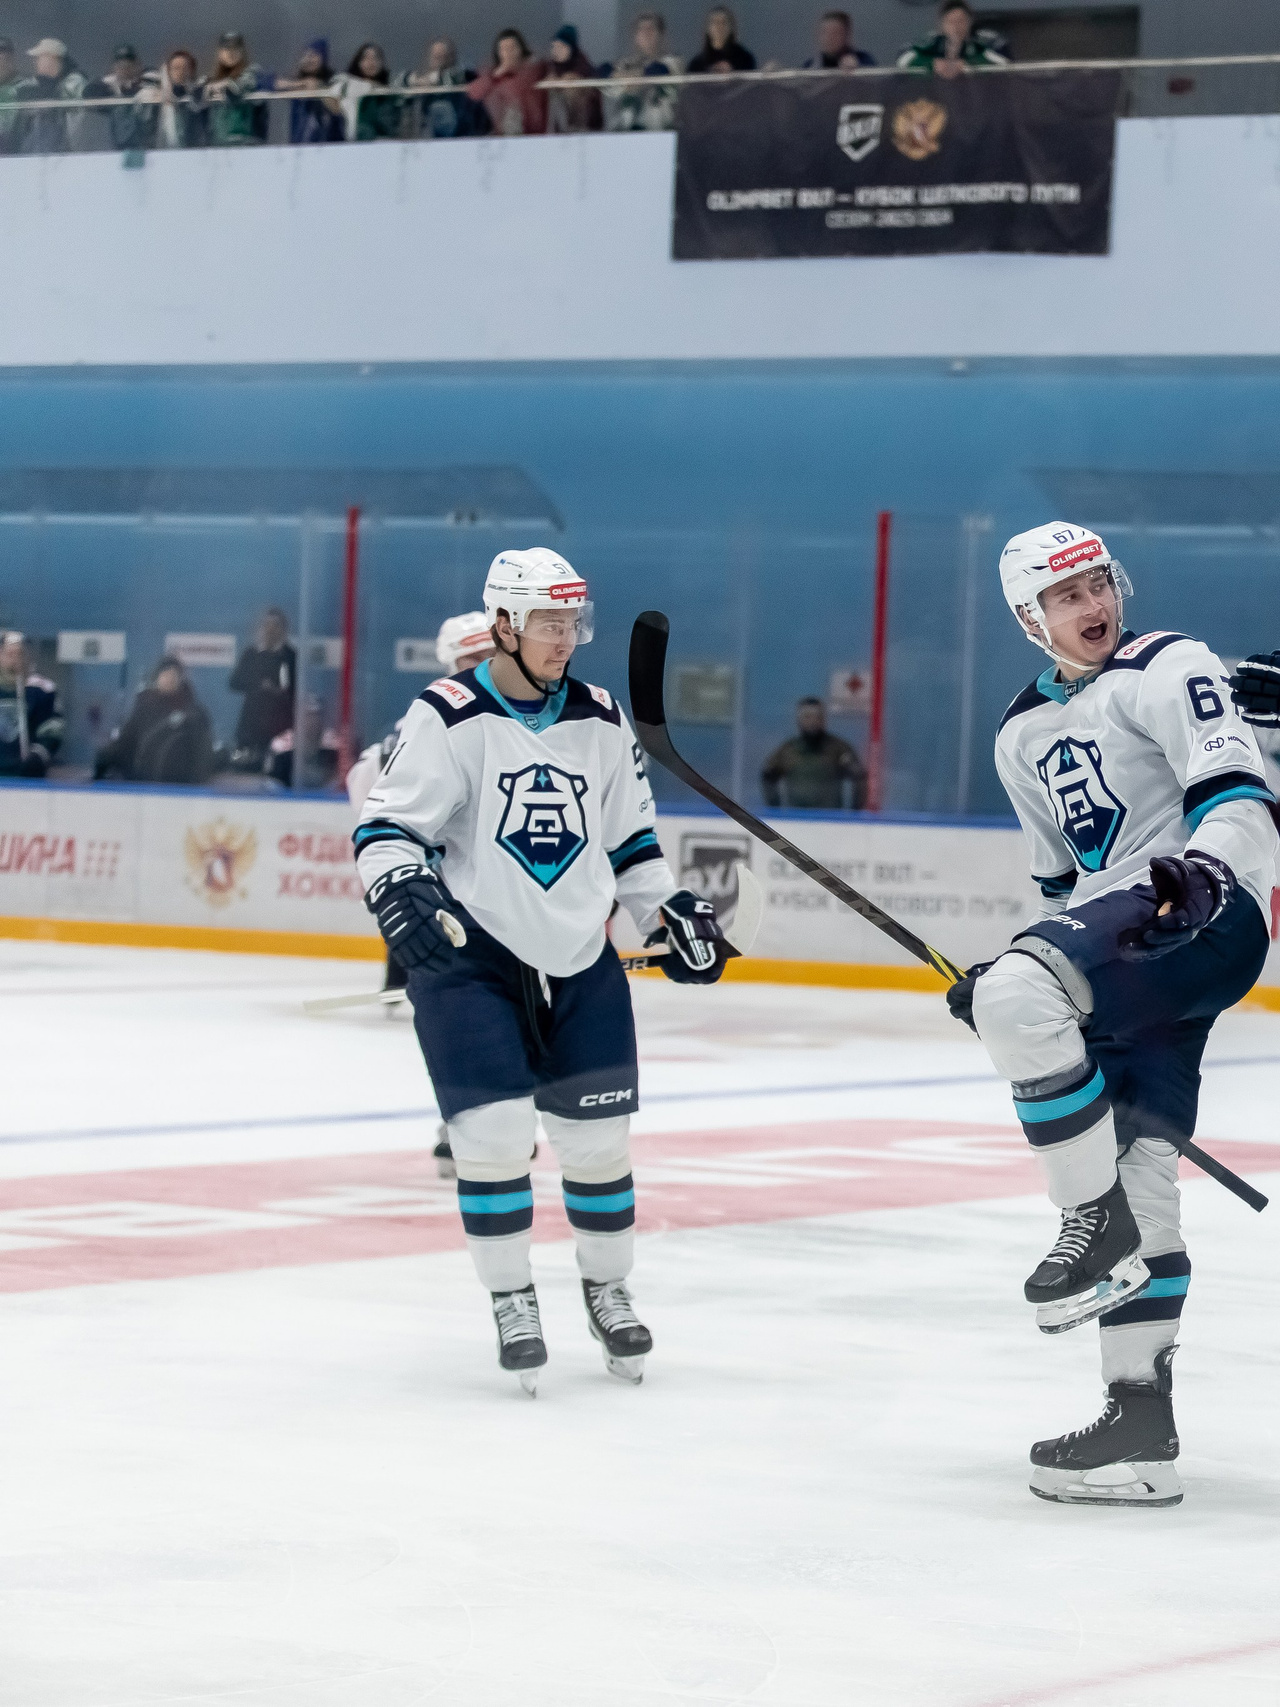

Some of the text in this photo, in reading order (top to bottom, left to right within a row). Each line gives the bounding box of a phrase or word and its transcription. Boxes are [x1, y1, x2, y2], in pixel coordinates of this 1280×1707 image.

[1052, 529, 1075, 544] 67
[1051, 543, 1100, 567] OLIMPBET
[579, 1088, 633, 1108] CCM
